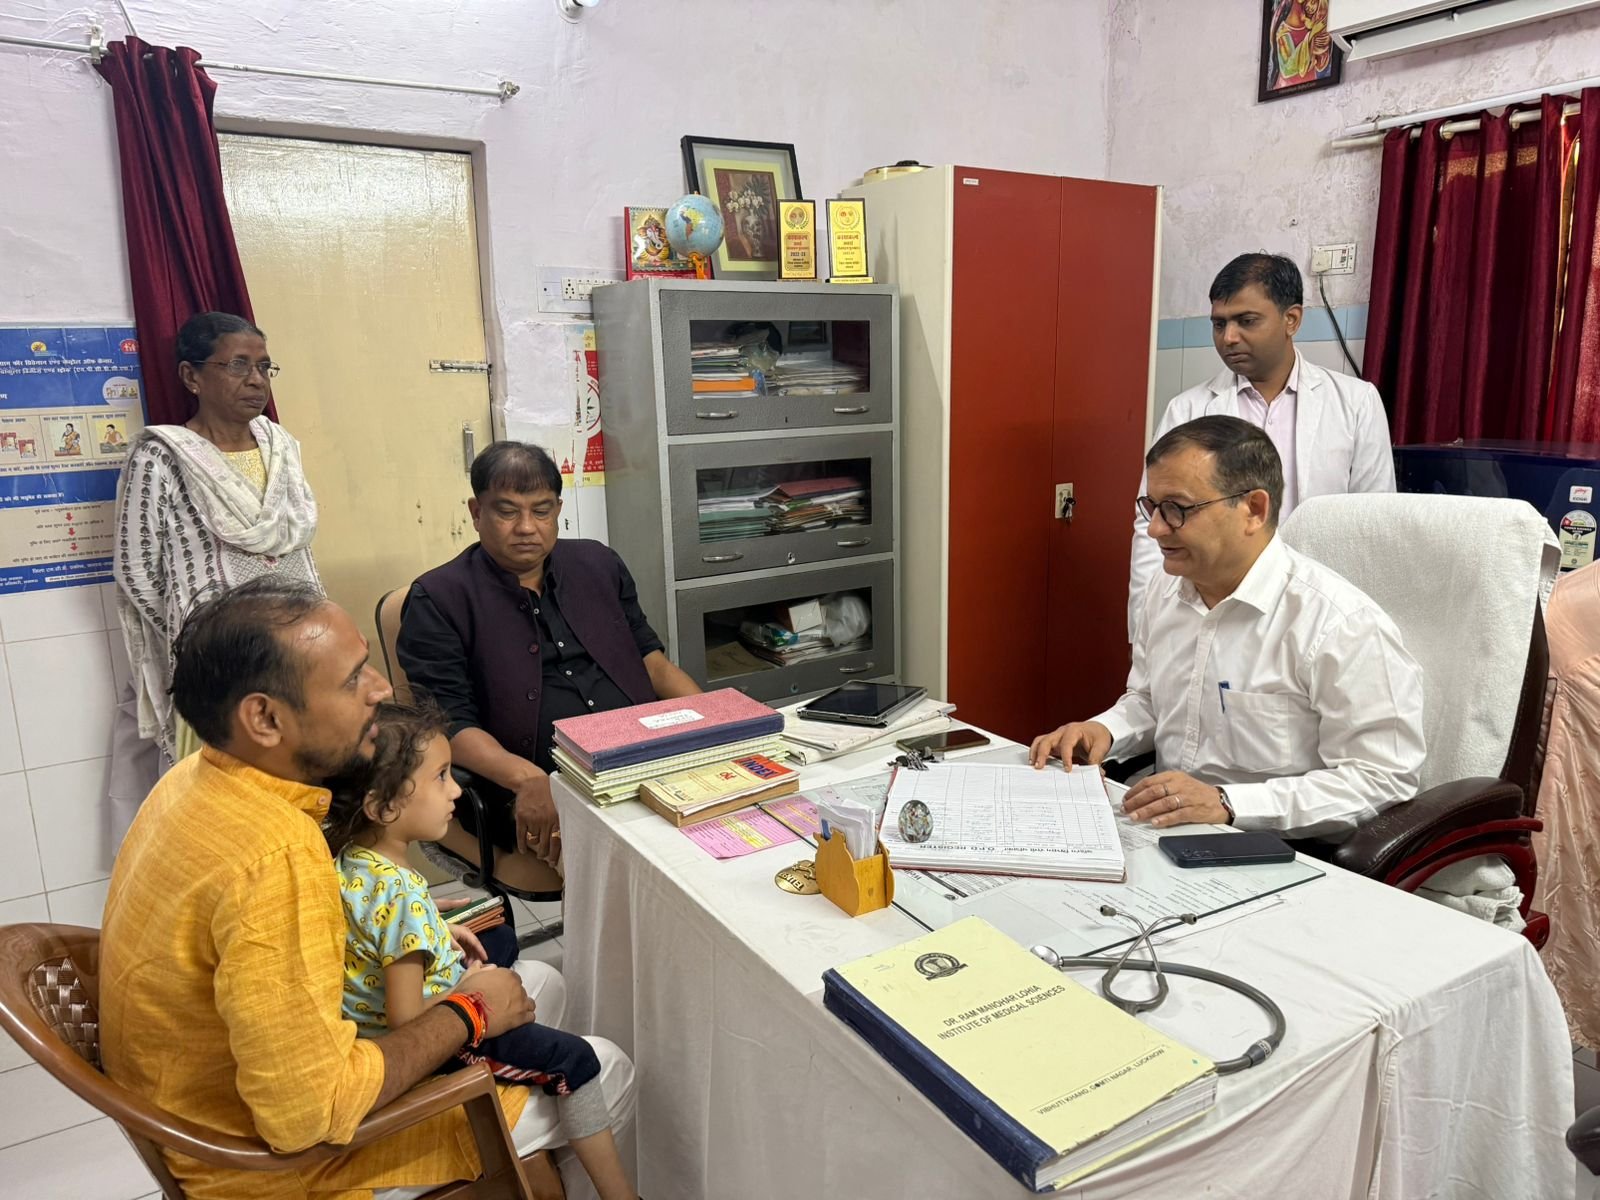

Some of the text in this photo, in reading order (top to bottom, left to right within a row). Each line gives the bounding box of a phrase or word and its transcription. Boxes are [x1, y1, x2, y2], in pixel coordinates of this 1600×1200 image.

[741, 759, 777, 778] INDEX
[937, 984, 1066, 1041] INSTITUTE OF MEDICAL SCIENCES
[943, 984, 1041, 1027] DR. RAM MANOHAR LOHIA
[1037, 1100, 1065, 1115] VIBHUTI
[1089, 1078, 1111, 1091] GMTI
[1134, 1048, 1165, 1068] LUCKNOW
